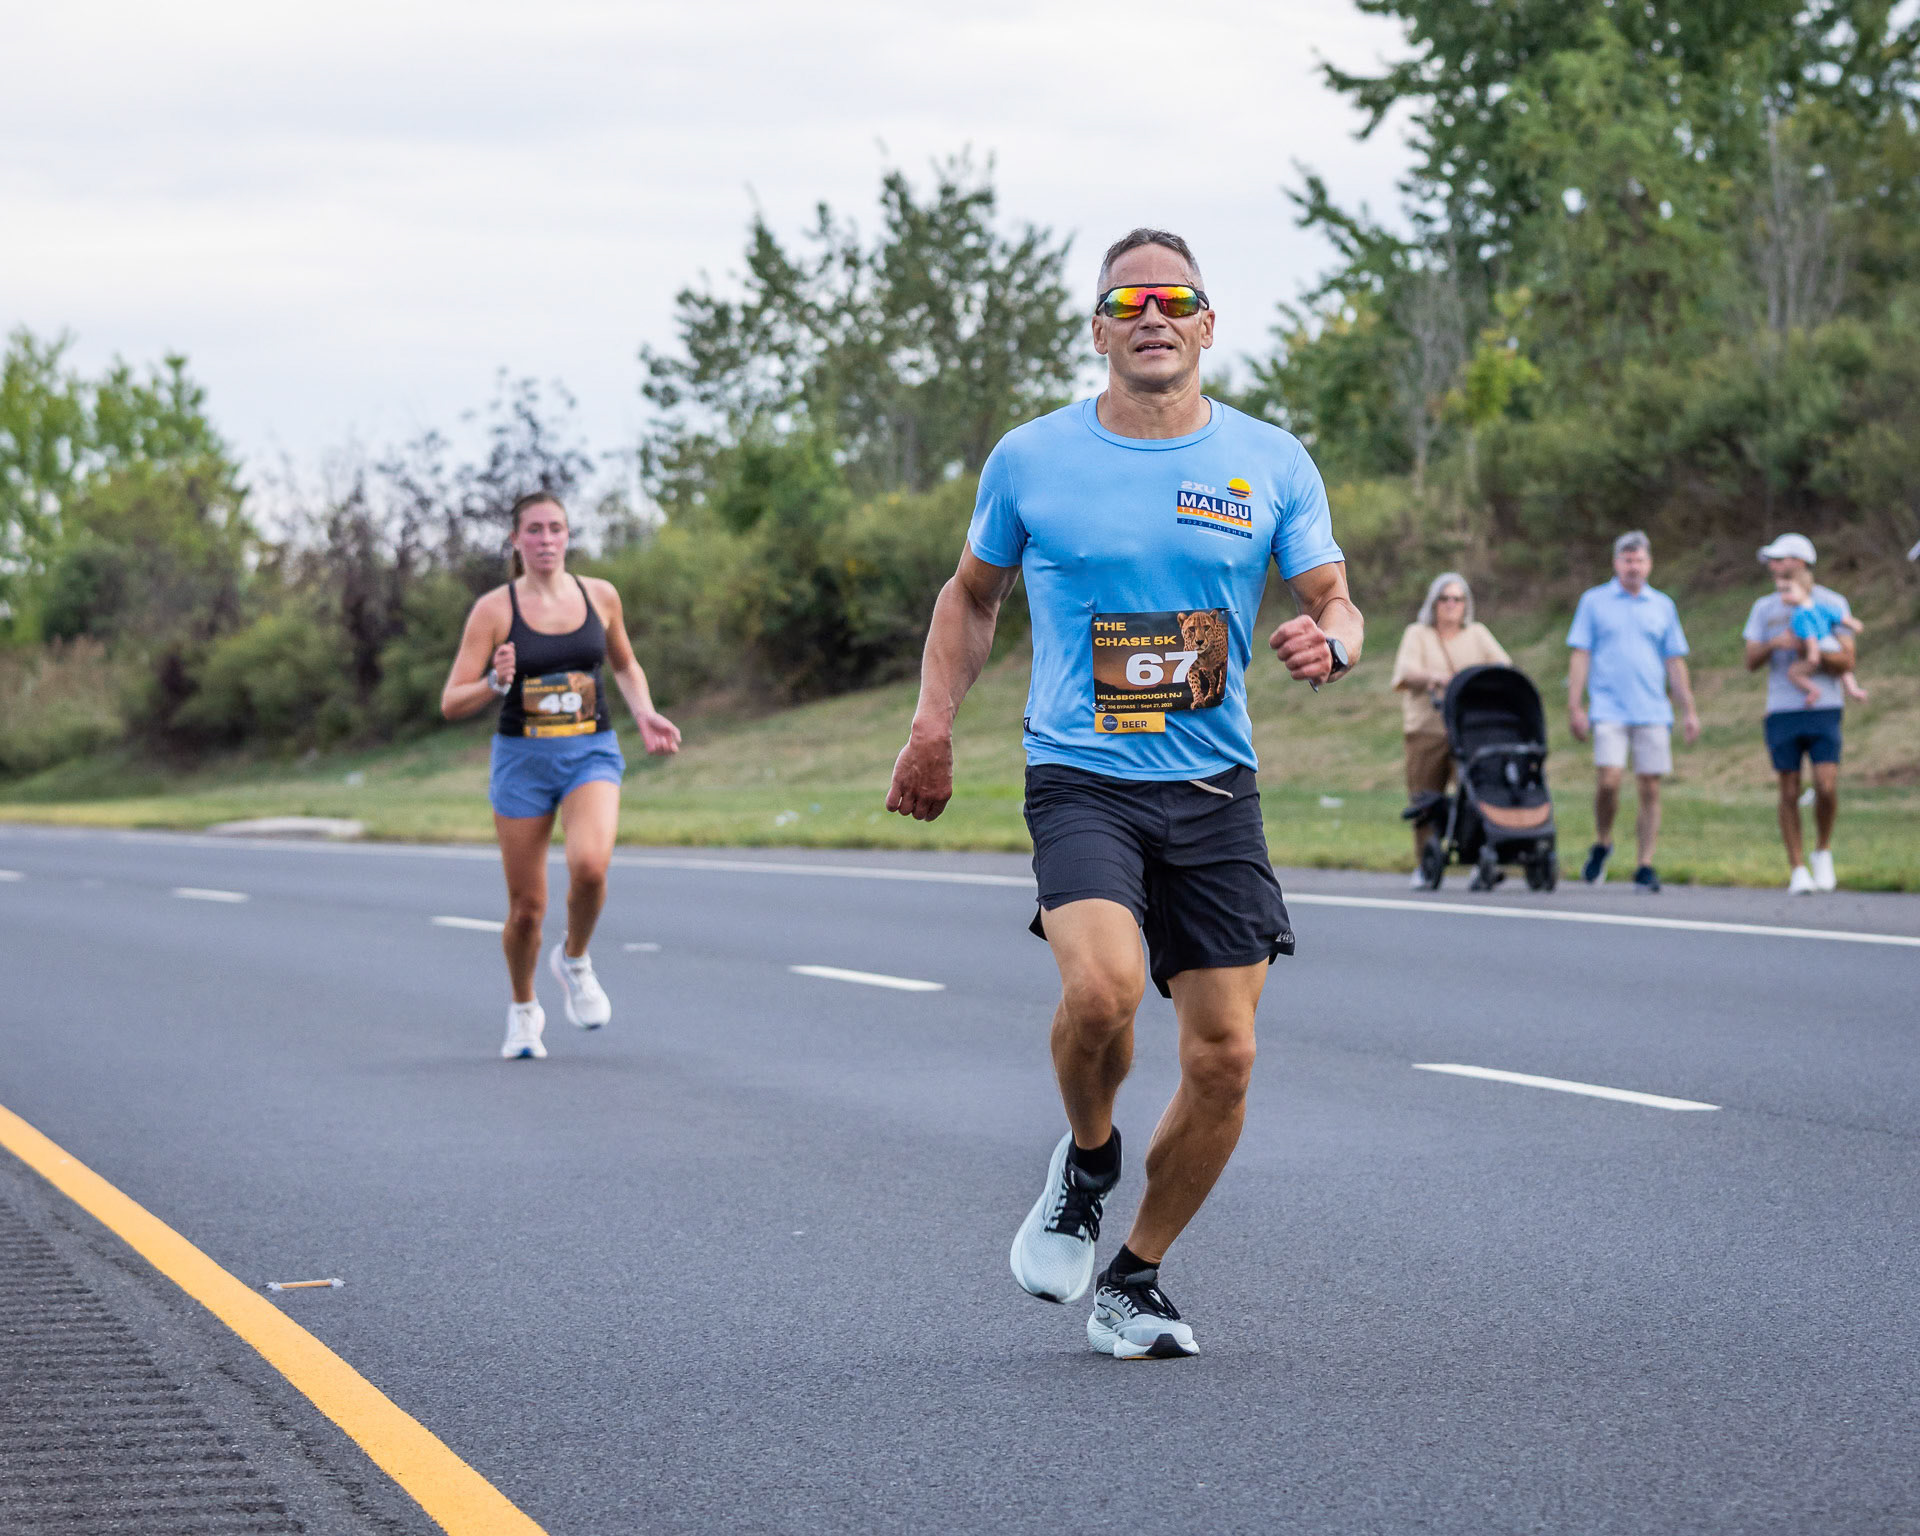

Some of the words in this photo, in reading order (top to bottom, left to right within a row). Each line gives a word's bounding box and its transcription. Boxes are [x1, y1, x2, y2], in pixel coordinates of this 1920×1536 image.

[1180, 480, 1216, 494] 2XU
[1180, 492, 1249, 520] MALIBU
[1181, 507, 1248, 526] TRIATHLON
[1094, 622, 1127, 631] THE
[1094, 636, 1151, 647] CHASE
[1153, 635, 1177, 645] 5K
[1126, 651, 1198, 686] 67
[538, 692, 582, 714] 49
